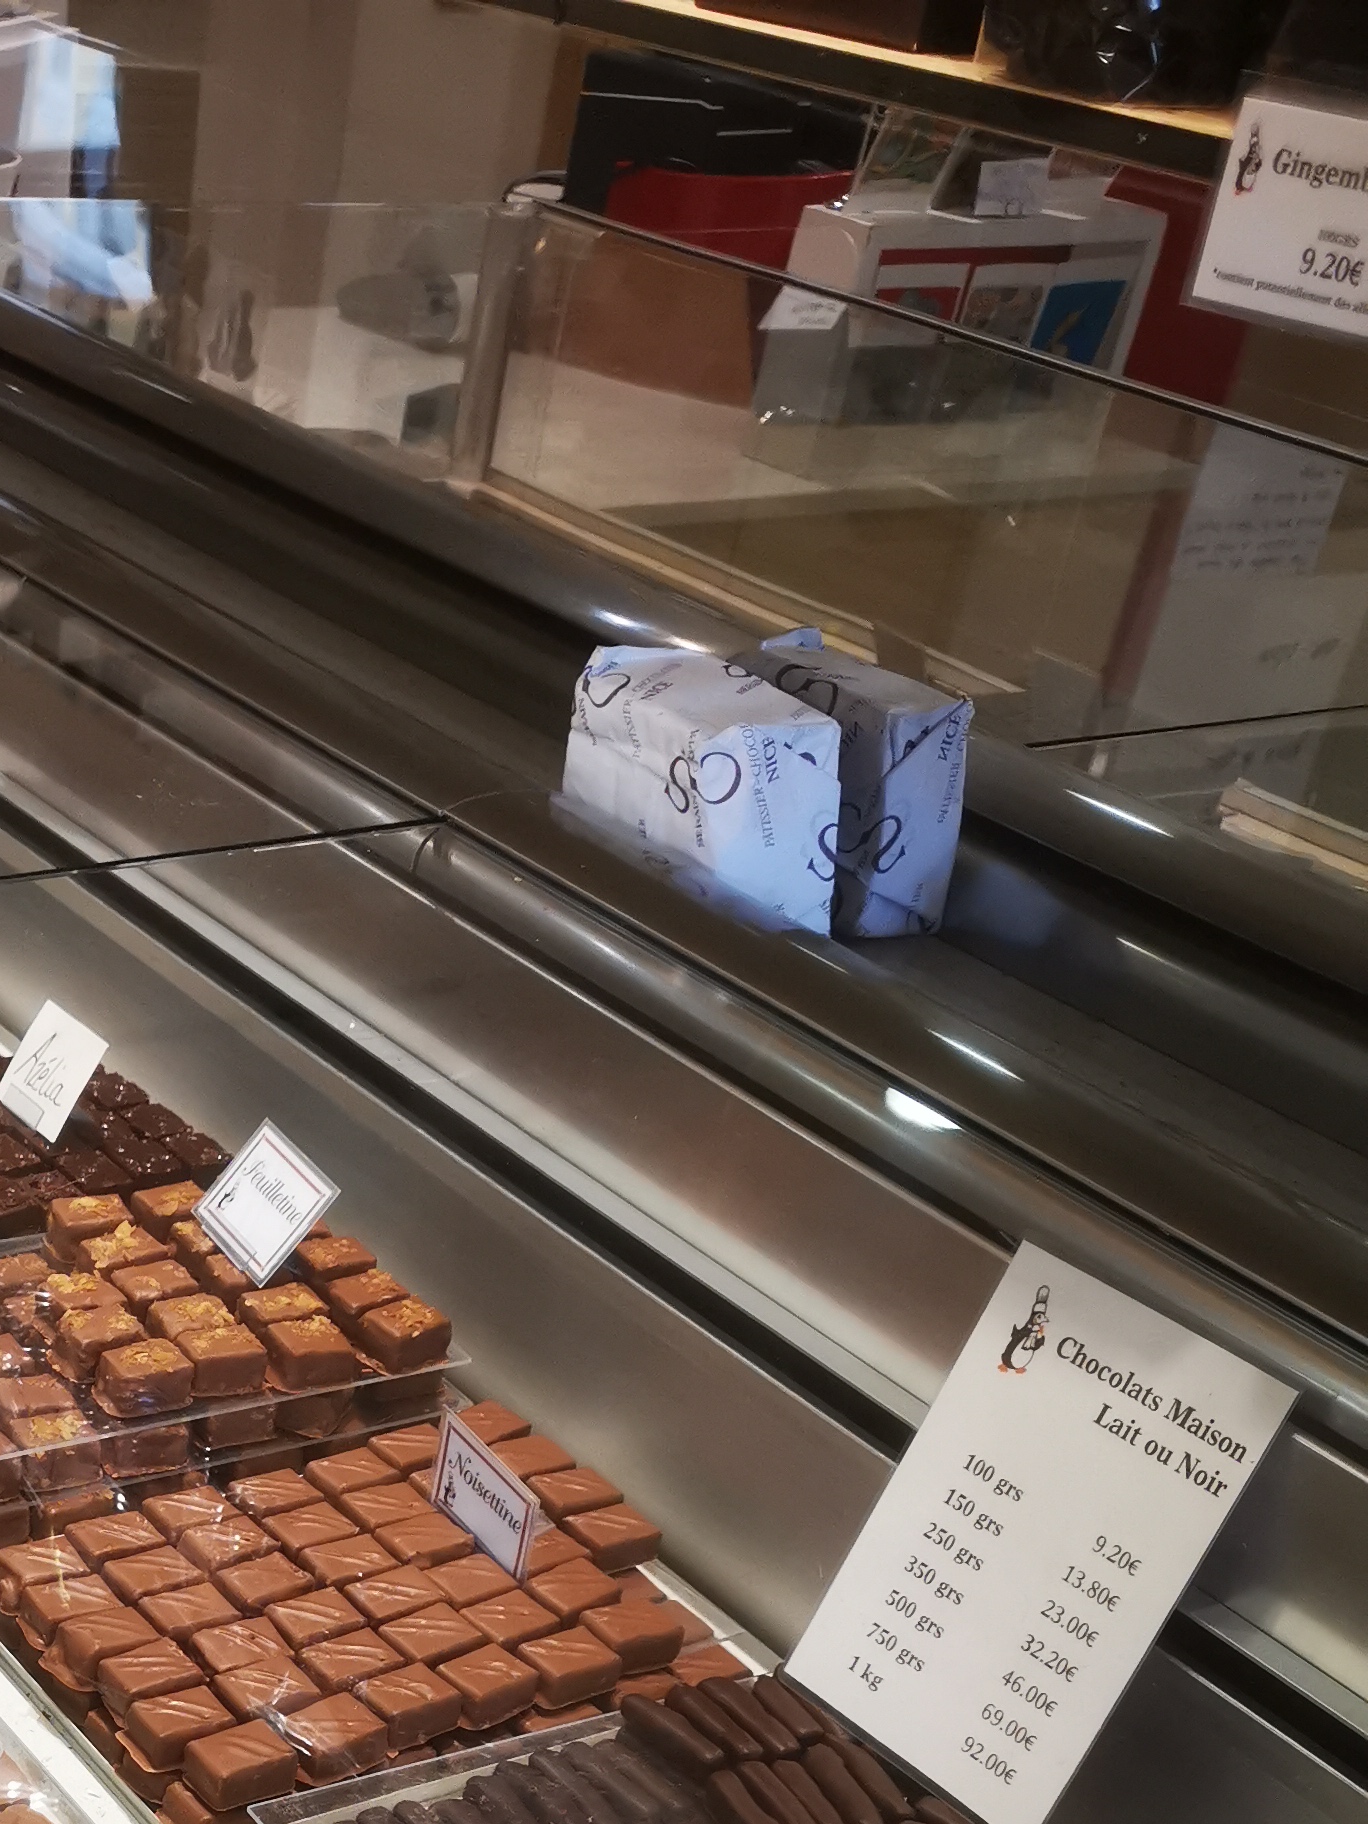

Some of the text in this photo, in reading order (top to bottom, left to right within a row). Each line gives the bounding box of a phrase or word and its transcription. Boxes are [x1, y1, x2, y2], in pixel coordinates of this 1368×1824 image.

[1300, 248, 1365, 287] 9.20€
[242, 1159, 303, 1226] Feuilletine
[1056, 1336, 1248, 1464] Chocolats Maison
[1093, 1402, 1228, 1498] Lait ou Noir
[448, 1451, 522, 1535] Noisettine
[942, 1488, 1122, 1613] 150 grs 13.80€
[962, 1454, 1143, 1577] 100 grs 9.20€
[903, 1555, 1079, 1683] 350 grs 32.20€
[922, 1522, 1101, 1648] 250 grs 23.00€
[865, 1622, 1038, 1752] 750 grs 69.00€
[884, 1588, 1059, 1718] 500 grs 46.00€
[848, 1655, 1018, 1786] 1 kg 92.00€
